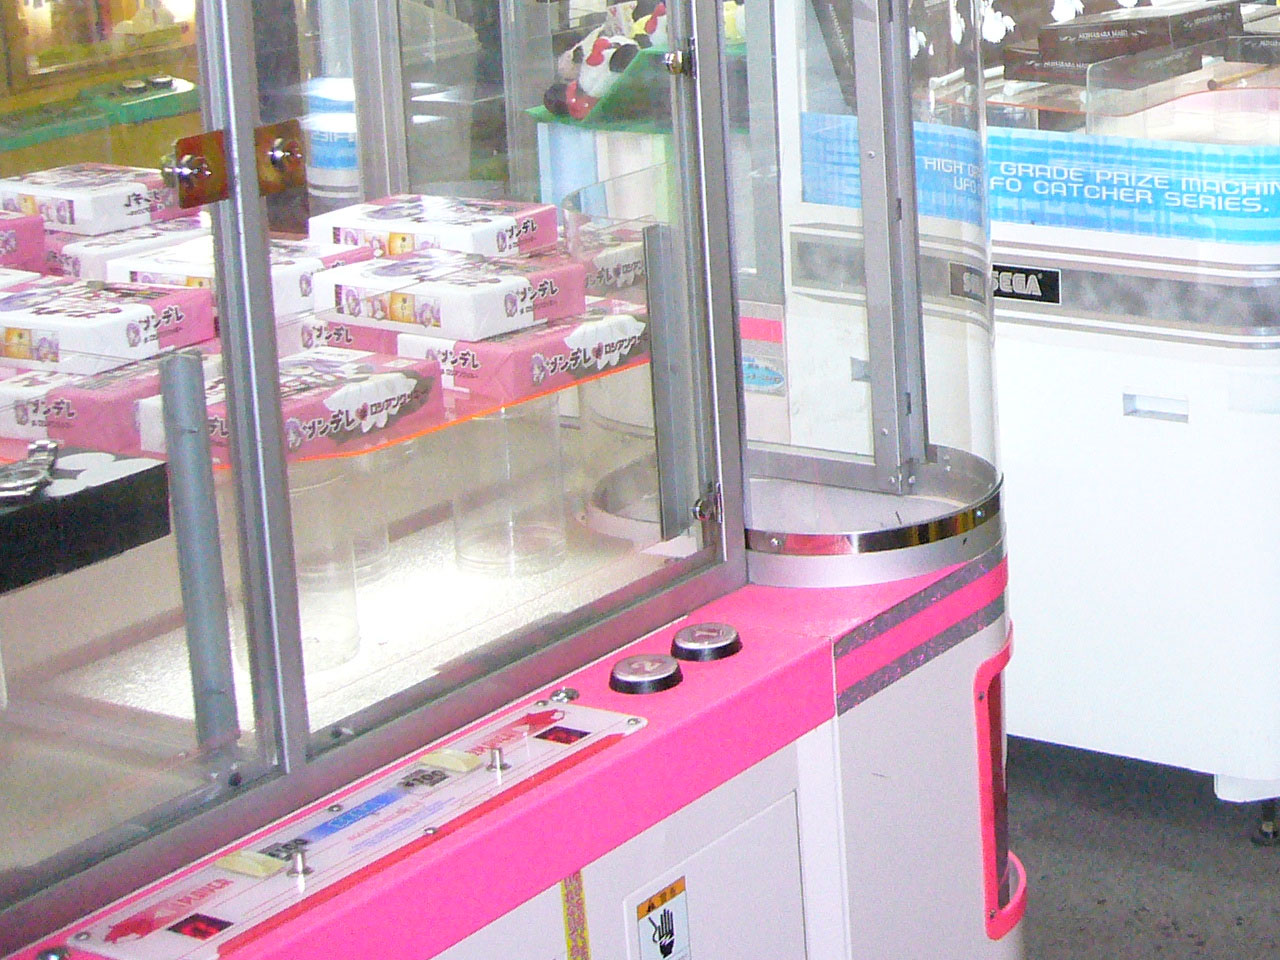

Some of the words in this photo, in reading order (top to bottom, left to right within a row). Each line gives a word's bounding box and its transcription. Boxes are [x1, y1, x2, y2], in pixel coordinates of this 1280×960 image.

[923, 157, 964, 175] HIGH
[1000, 161, 1085, 182] GRADE
[1095, 169, 1170, 190] PRIZE
[1033, 180, 1153, 204] CATCHER
[1165, 191, 1270, 213] SERIES.
[990, 270, 1042, 296] SEGA
